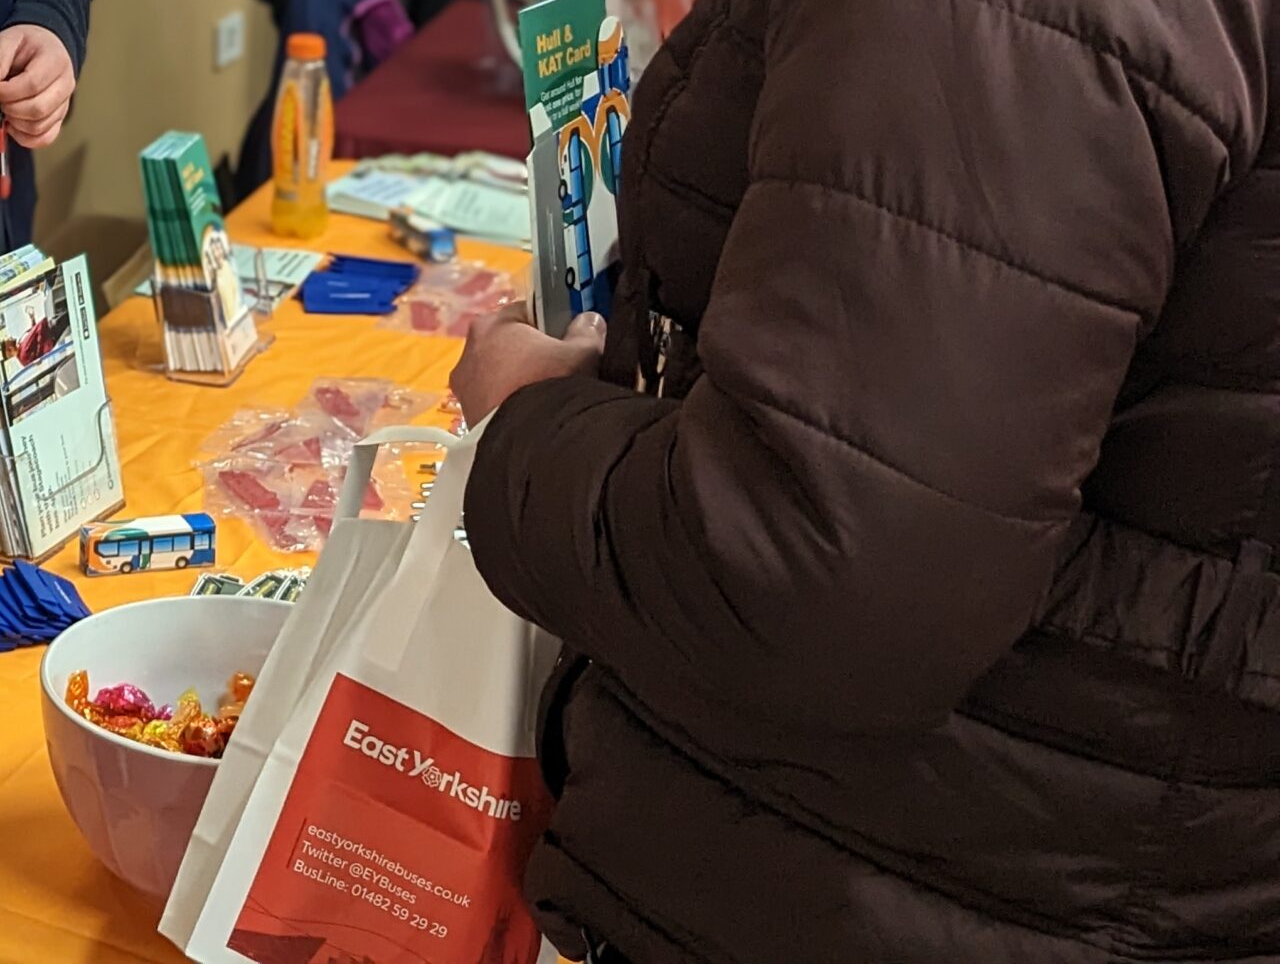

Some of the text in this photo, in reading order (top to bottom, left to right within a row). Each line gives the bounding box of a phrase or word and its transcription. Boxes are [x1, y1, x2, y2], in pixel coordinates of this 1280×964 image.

[536, 24, 573, 54] Hull &
[538, 39, 591, 78] KAT Card
[301, 840, 417, 904] Twitter @EYBuses
[307, 824, 471, 908] eastyorkshirebuses.co.uk
[294, 859, 449, 938] BusLine: 01482 59 29 29
